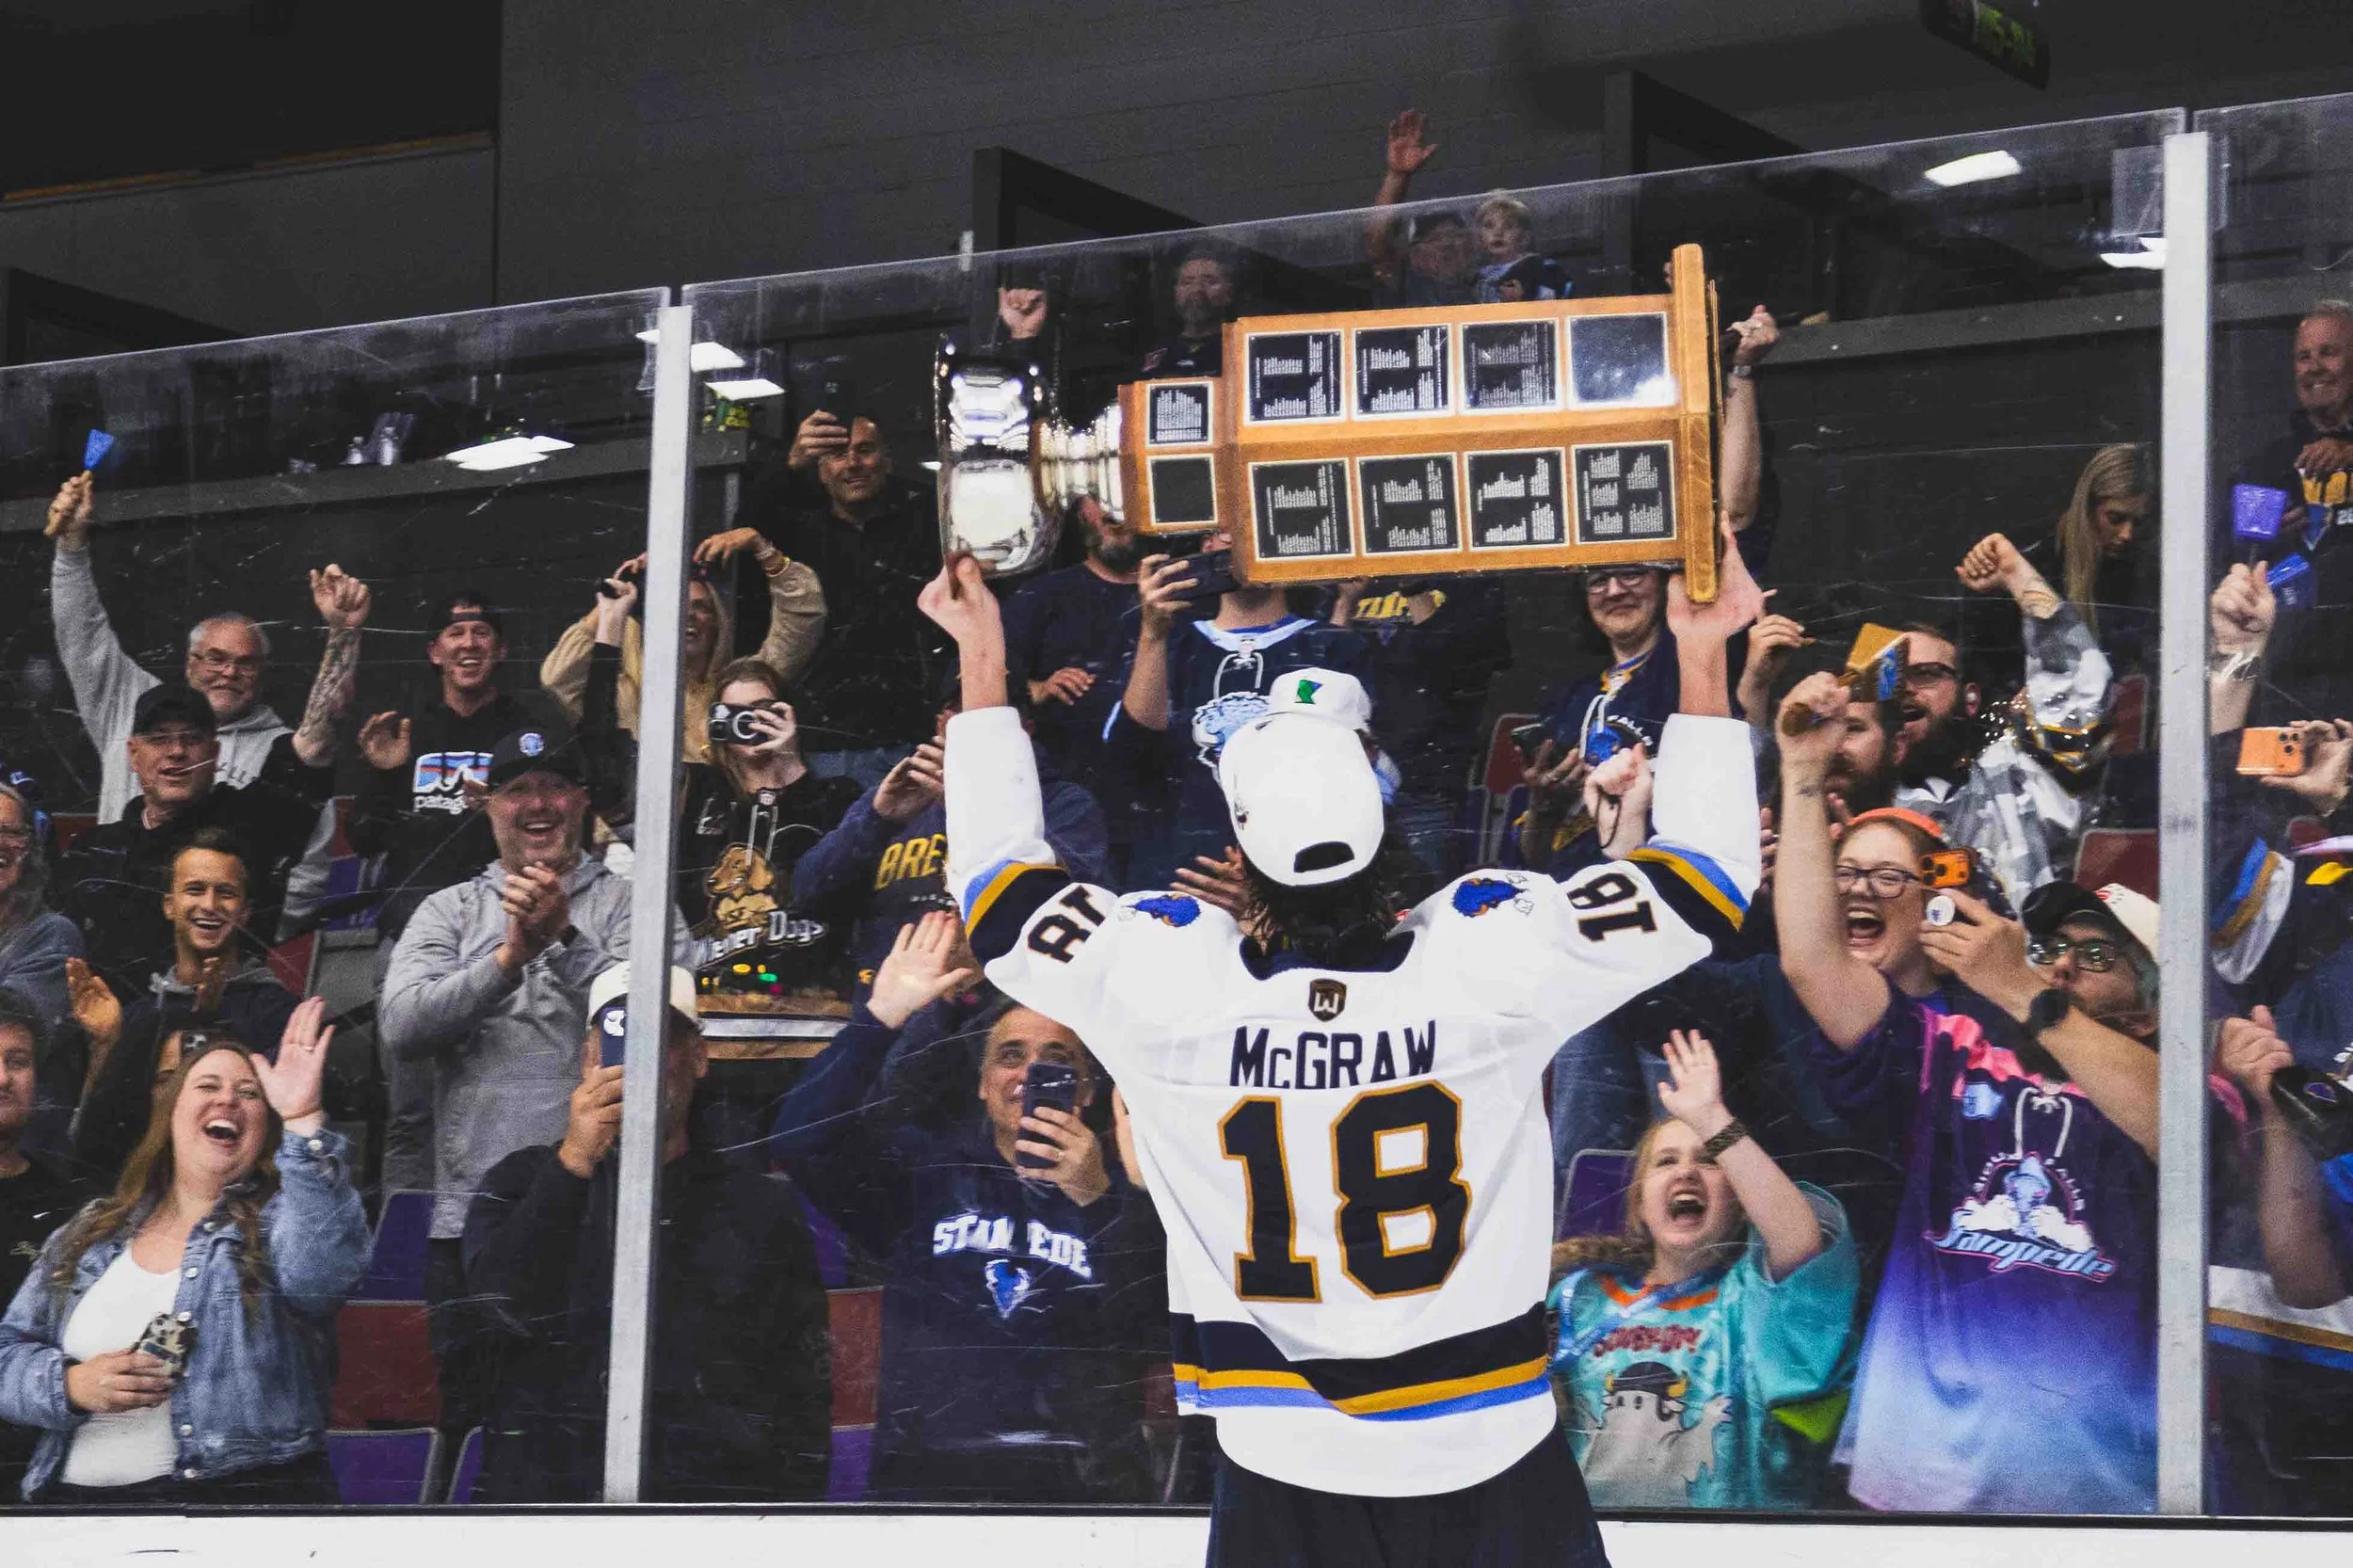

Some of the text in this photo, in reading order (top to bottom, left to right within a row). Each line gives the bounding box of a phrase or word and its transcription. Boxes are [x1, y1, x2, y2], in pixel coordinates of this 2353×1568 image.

[413, 794, 469, 815] patag
[1566, 872, 1657, 941] 18
[1229, 1019, 1436, 1090] McGRAW
[1217, 1080, 1472, 1304] 18
[933, 1214, 1093, 1277] STAMEDE
